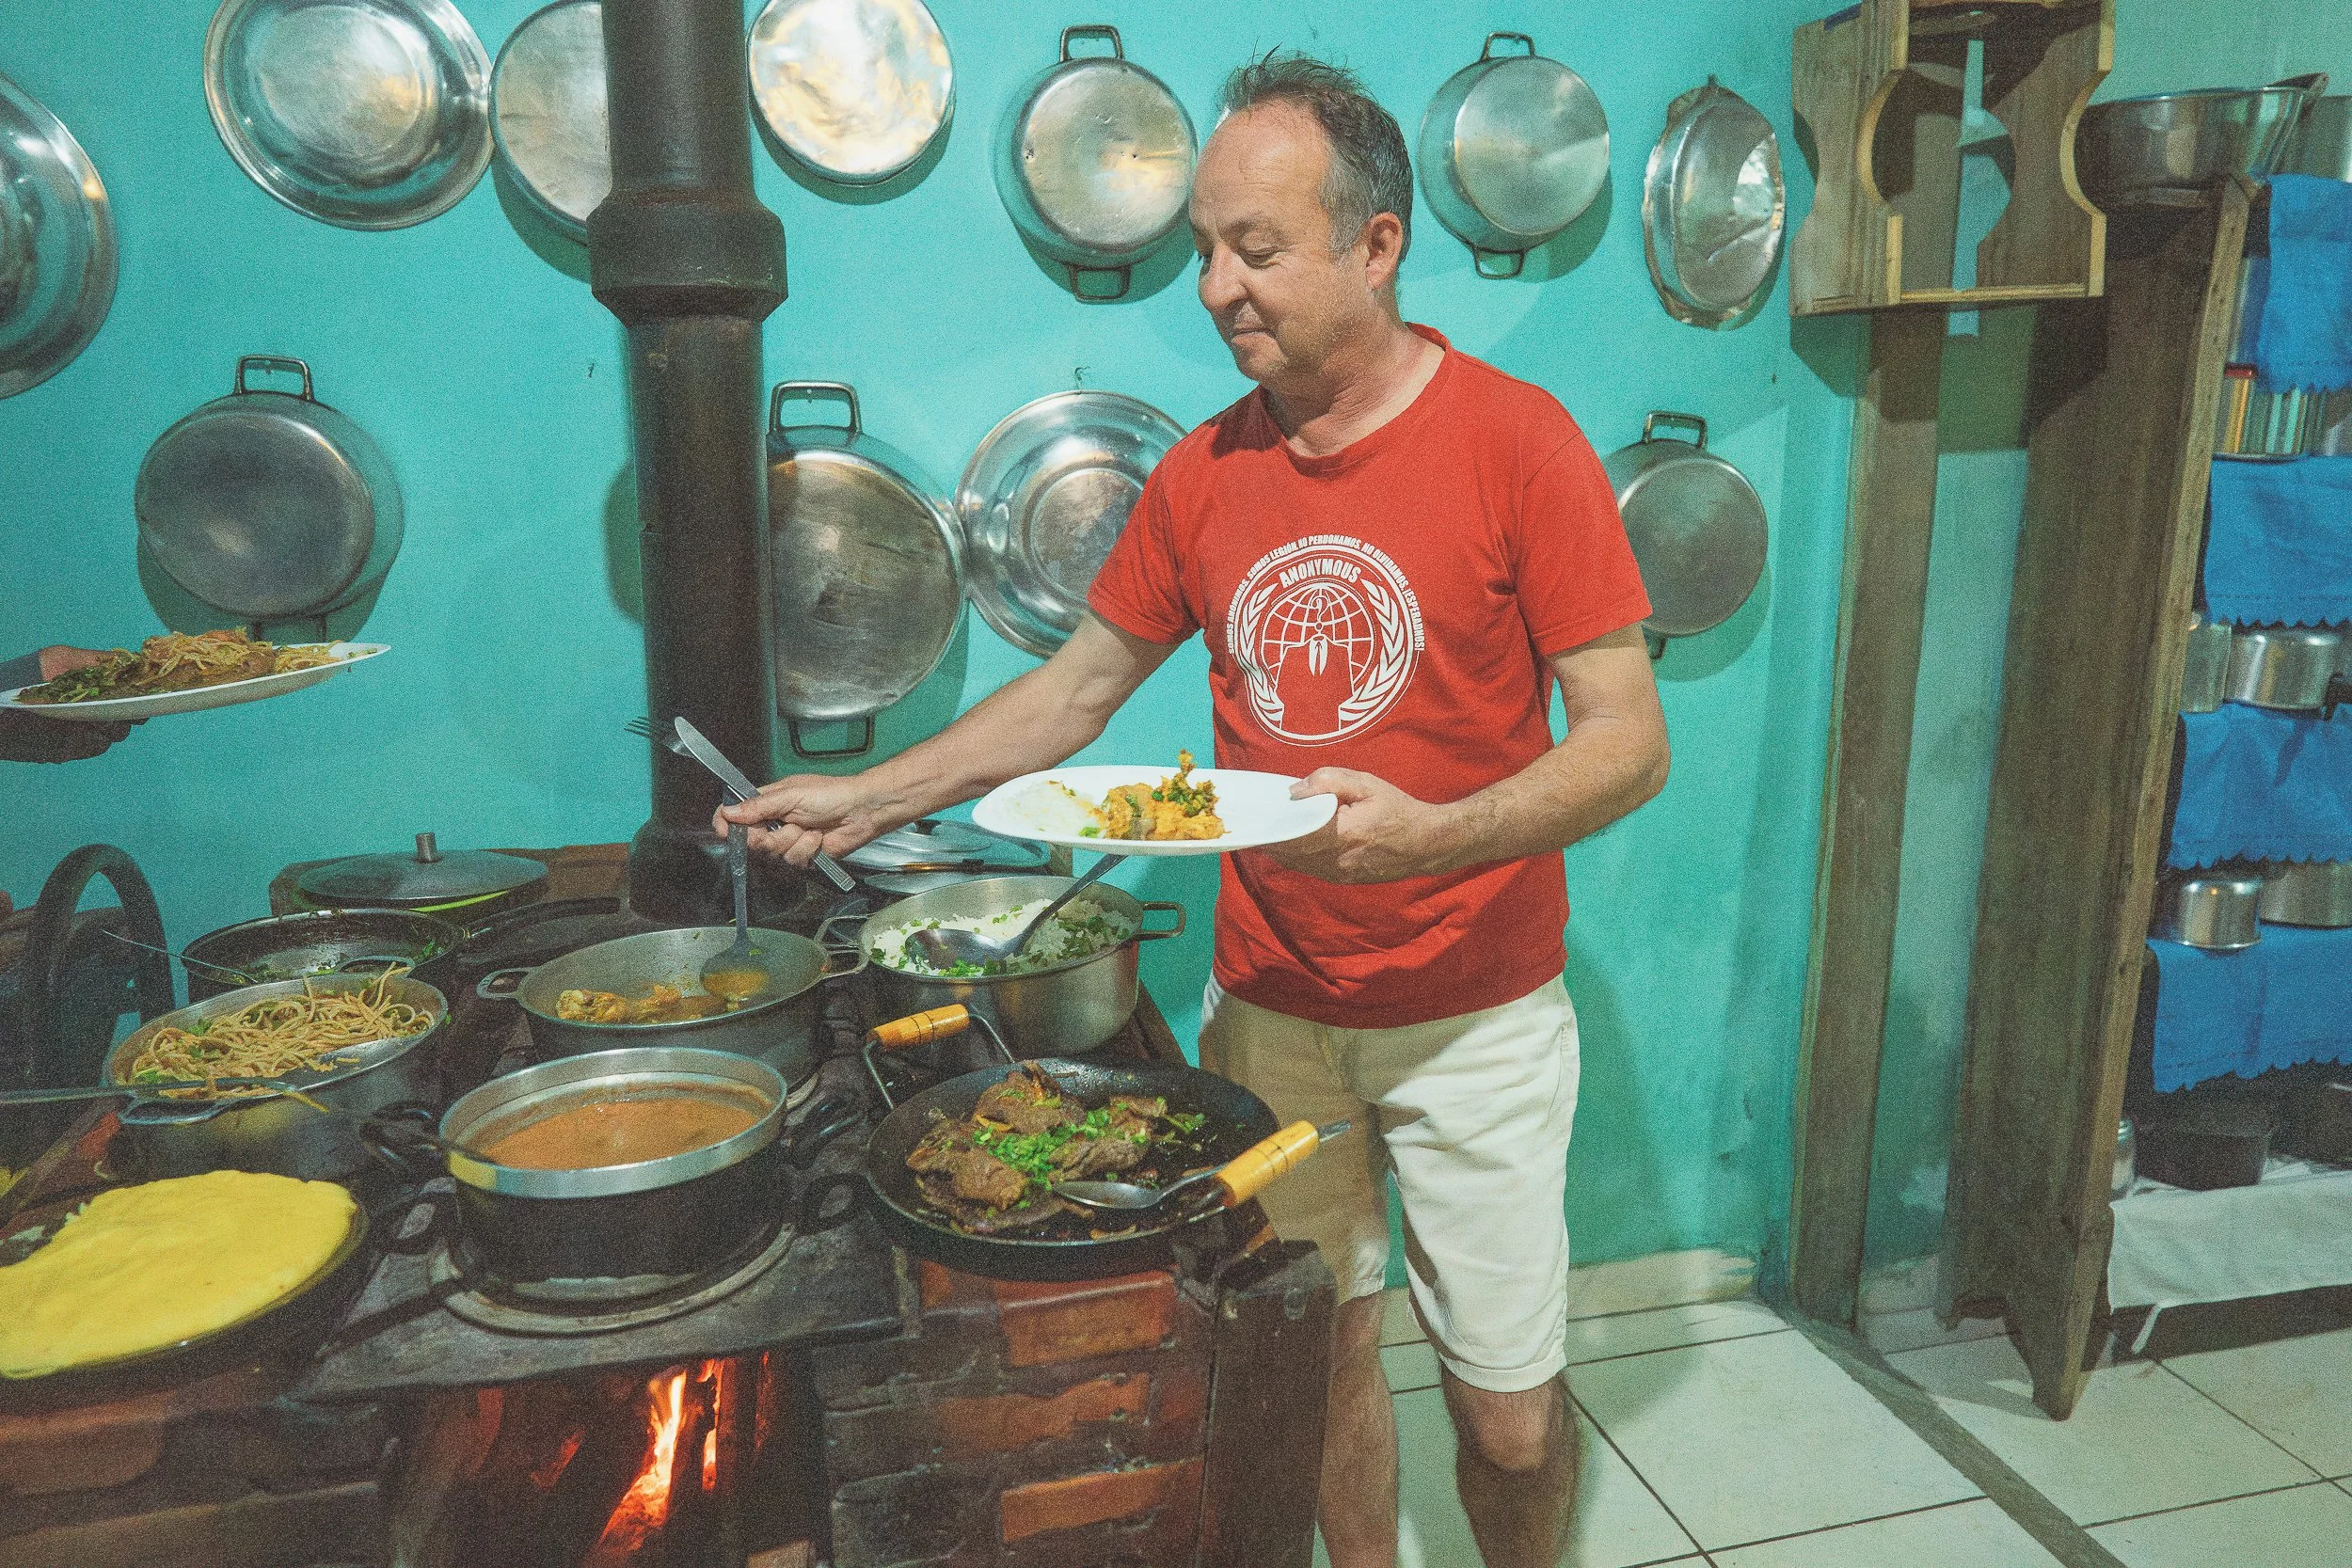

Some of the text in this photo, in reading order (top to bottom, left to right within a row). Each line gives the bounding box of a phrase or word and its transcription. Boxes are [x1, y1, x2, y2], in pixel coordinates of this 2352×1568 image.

[1227, 623, 1235, 655] SOMOS
[1247, 554, 1271, 579] SOMOS
[1297, 536, 1308, 549] NO
[1361, 543, 1375, 556] NO
[1374, 549, 1409, 591] OLVIDAMOS.
[1279, 558, 1361, 589] ANONYMOUS
